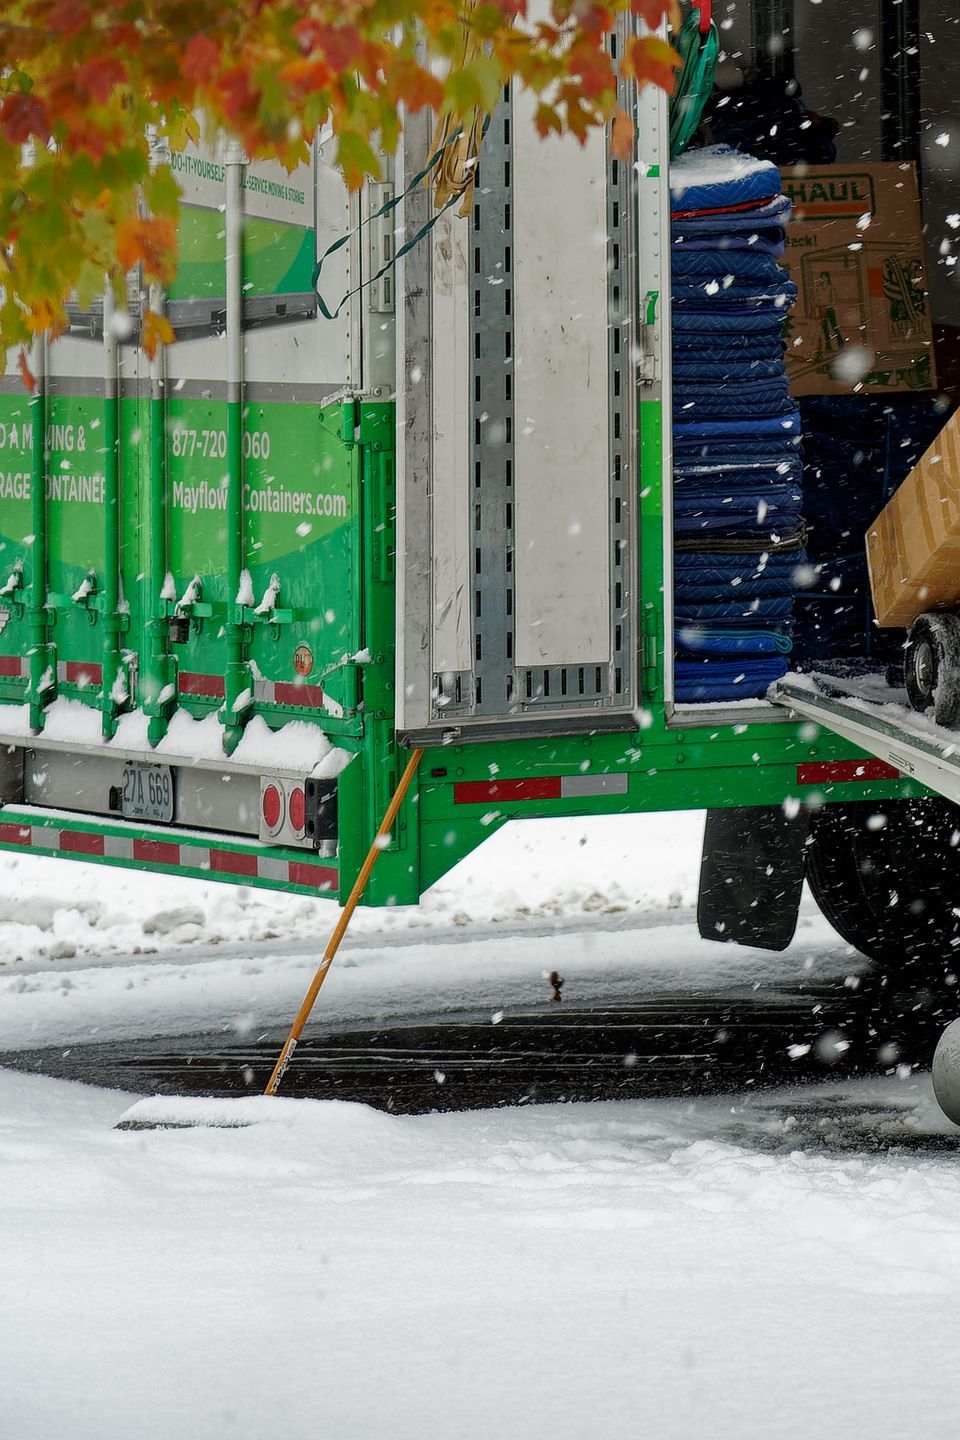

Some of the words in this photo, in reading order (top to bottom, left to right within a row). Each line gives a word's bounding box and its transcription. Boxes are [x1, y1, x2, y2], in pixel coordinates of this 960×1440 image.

[77, 424, 86, 453] &
[172, 480, 347, 518] MayflowContainers.com
[123, 769, 144, 805] 27A
[148, 772, 169, 806] 669
